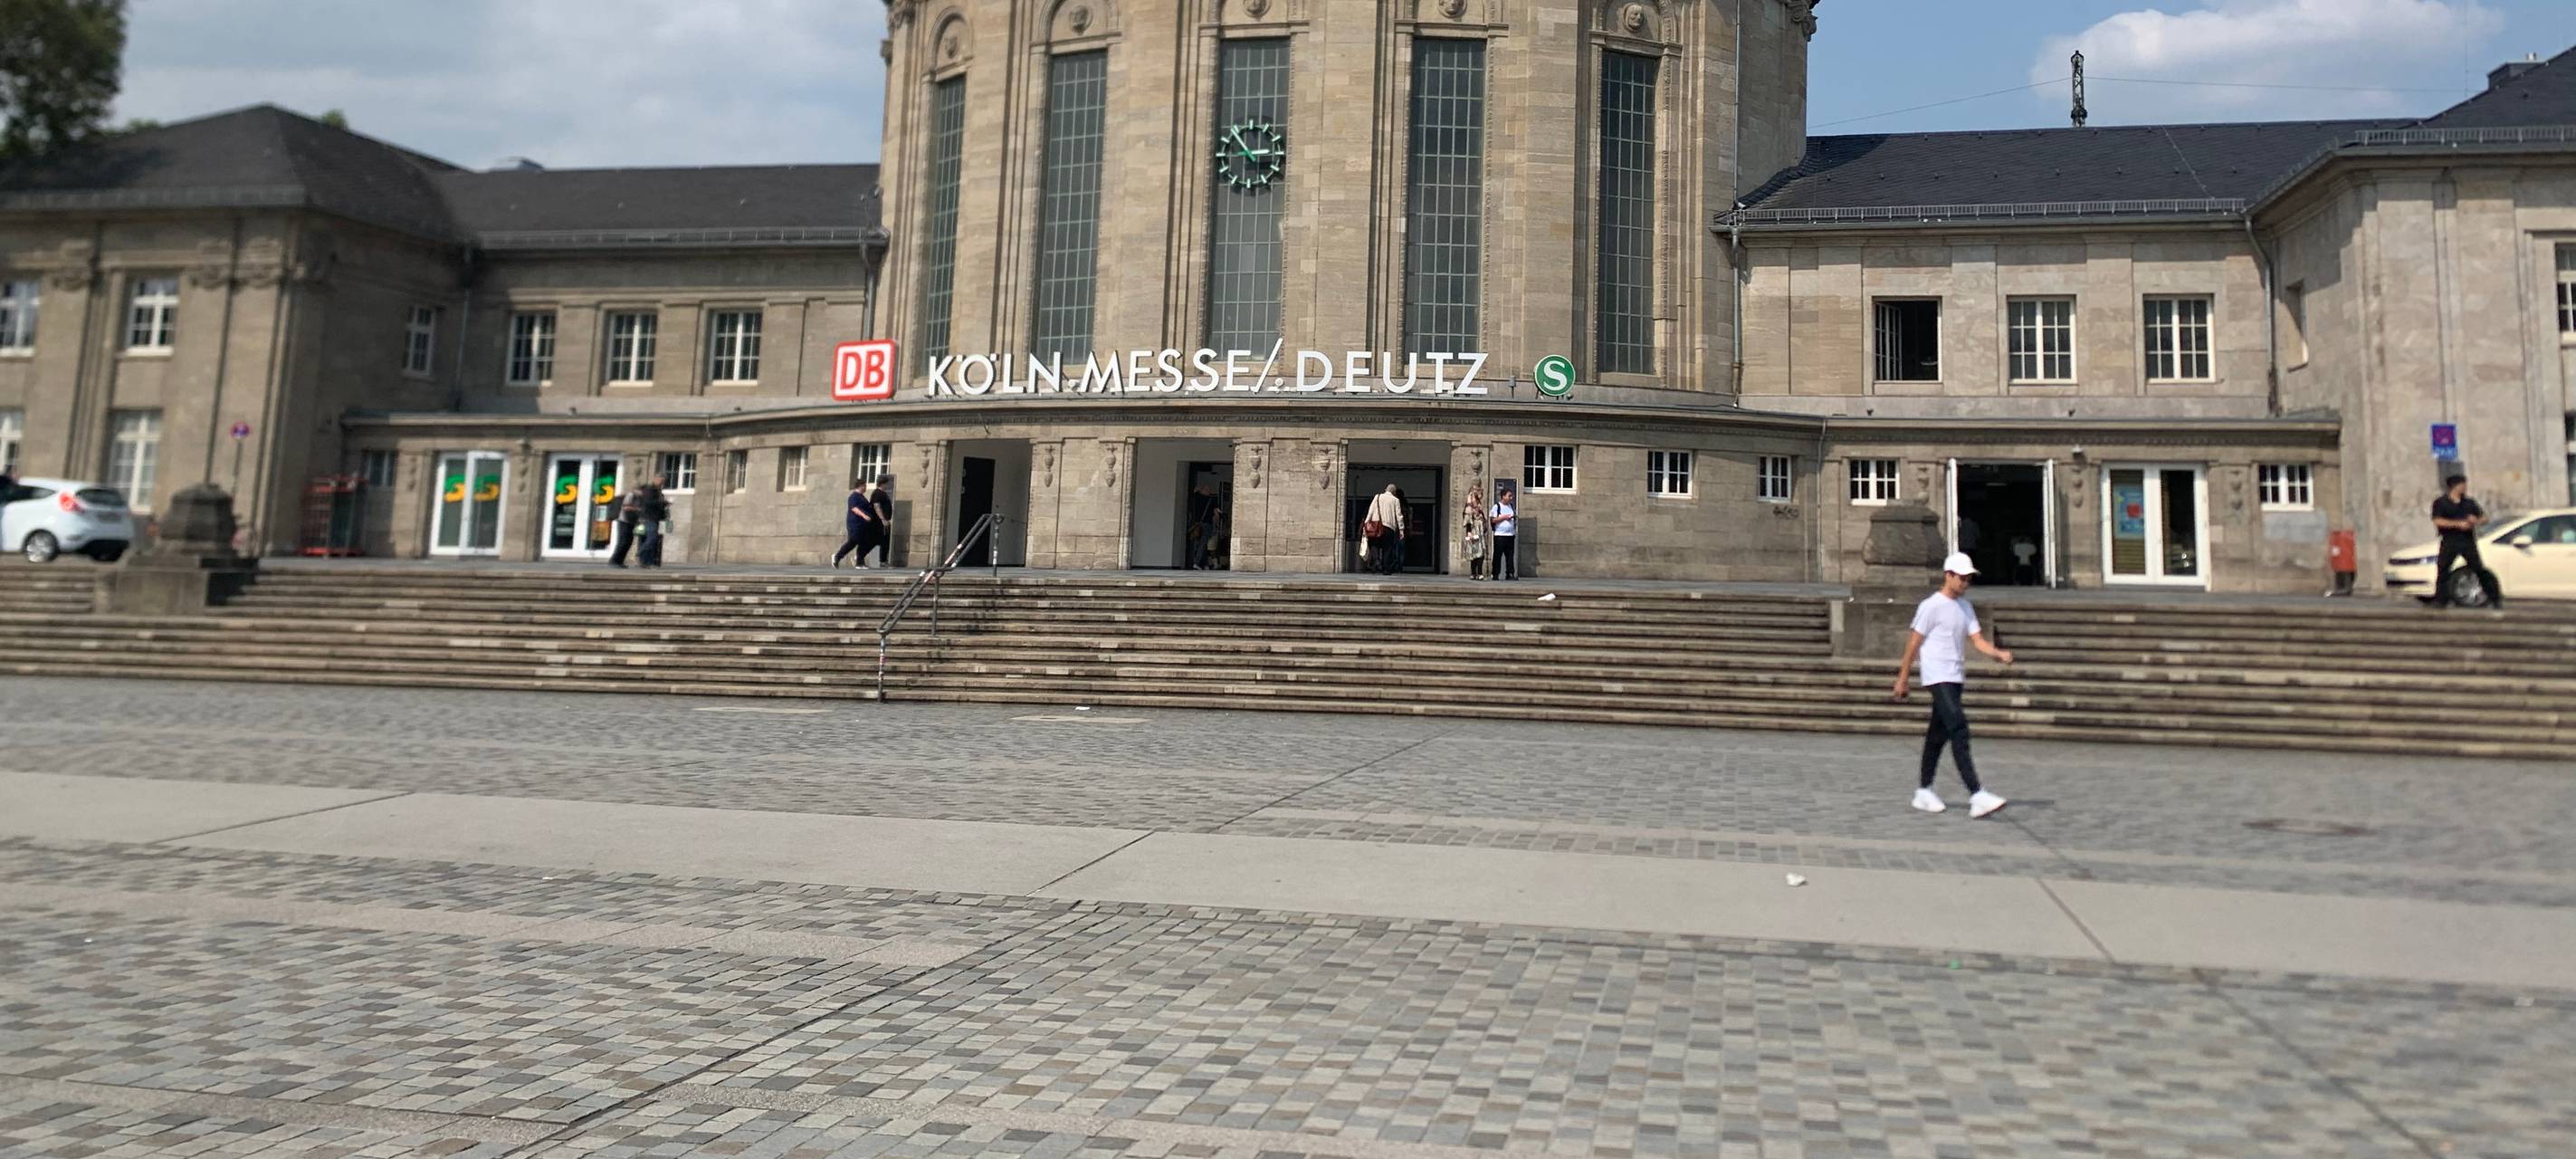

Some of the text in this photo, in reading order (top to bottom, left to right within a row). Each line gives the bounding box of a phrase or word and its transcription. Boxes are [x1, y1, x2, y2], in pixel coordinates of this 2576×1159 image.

[838, 350, 886, 390] DB
[928, 351, 1063, 396] KÖLN
[1542, 359, 1569, 392] S
